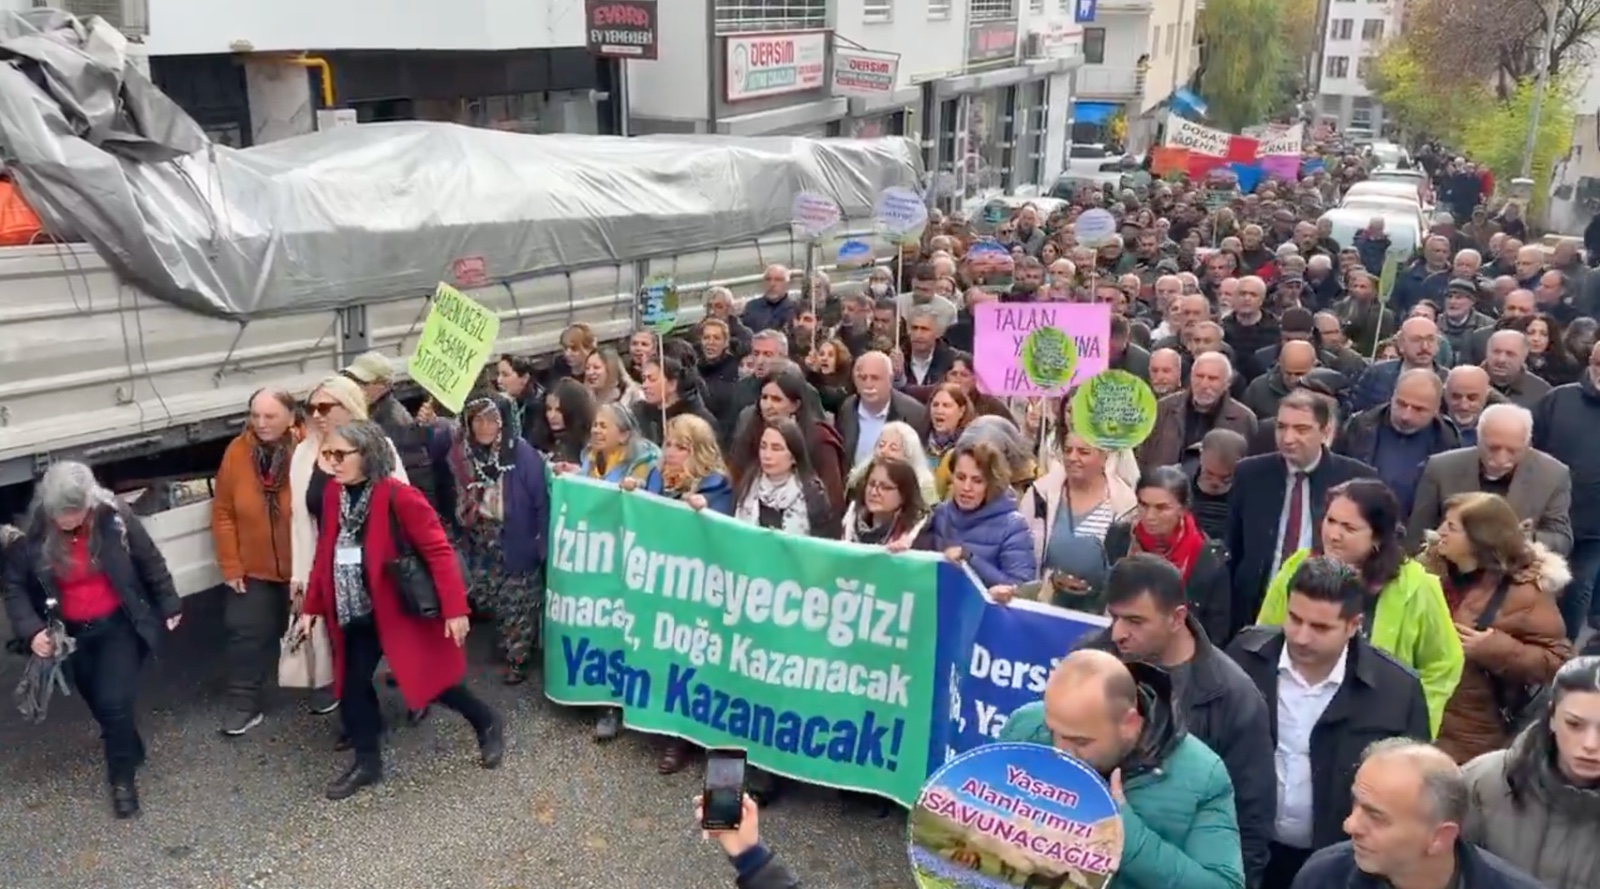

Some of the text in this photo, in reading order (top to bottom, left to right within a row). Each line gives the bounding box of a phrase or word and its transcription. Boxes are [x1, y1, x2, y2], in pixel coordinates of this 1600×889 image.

[591, 29, 604, 43] EV
[995, 308, 1056, 332] TALAN
[552, 503, 615, 574] İzin
[653, 611, 723, 667] Doğa
[729, 632, 912, 708] Kazanacak
[664, 662, 905, 773] Kazanacak!
[961, 777, 1095, 838] Alanlarımızı
[1007, 764, 1078, 808] Yaşam
[924, 792, 1114, 874] SAVUNACAĞIZ!
